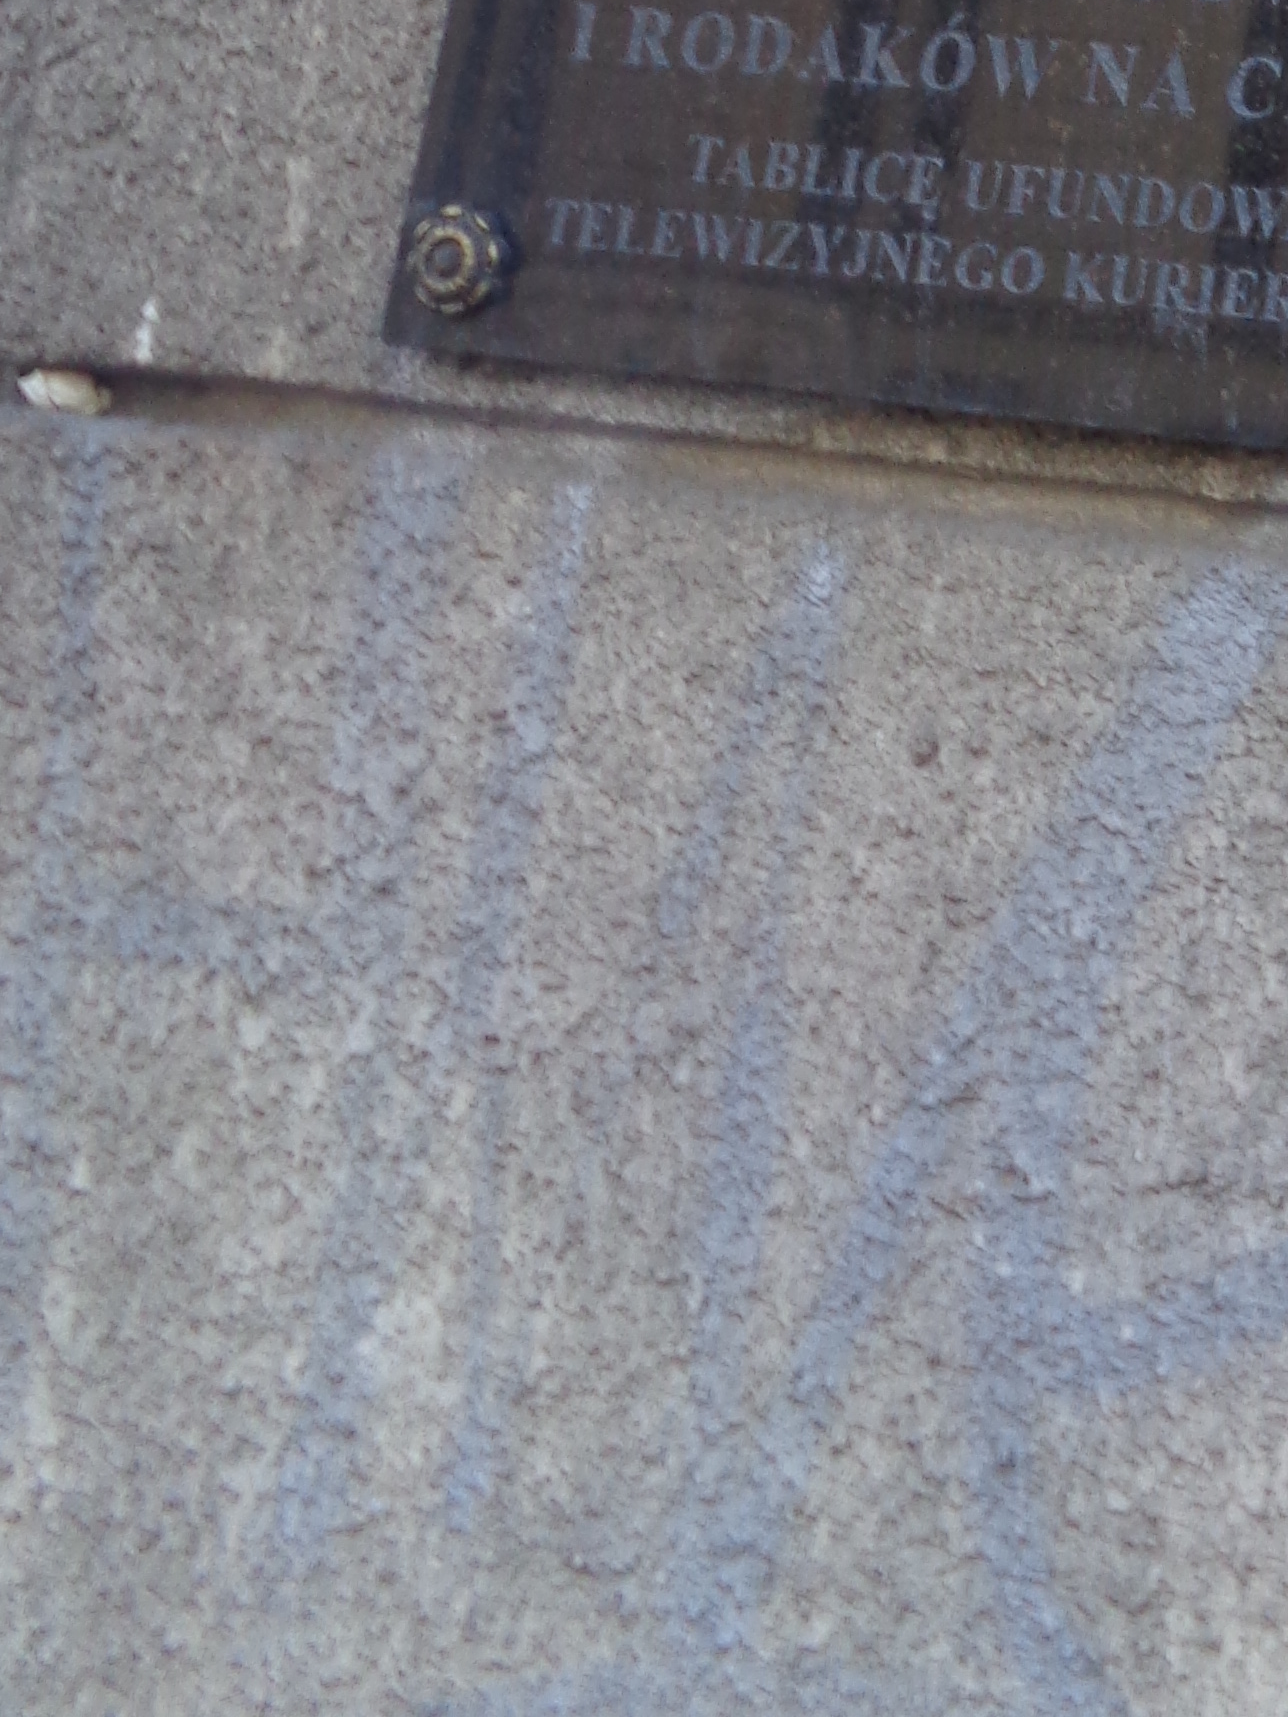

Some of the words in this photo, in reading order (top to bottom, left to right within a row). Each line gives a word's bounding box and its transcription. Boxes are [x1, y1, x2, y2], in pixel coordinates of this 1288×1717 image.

[568, 2, 601, 63] I
[622, 5, 1062, 104] RODAKÓW
[1080, 41, 1197, 119] NA
[687, 132, 945, 223] TABLICĘ
[544, 196, 1046, 297] TELEWIZYJNEGO
